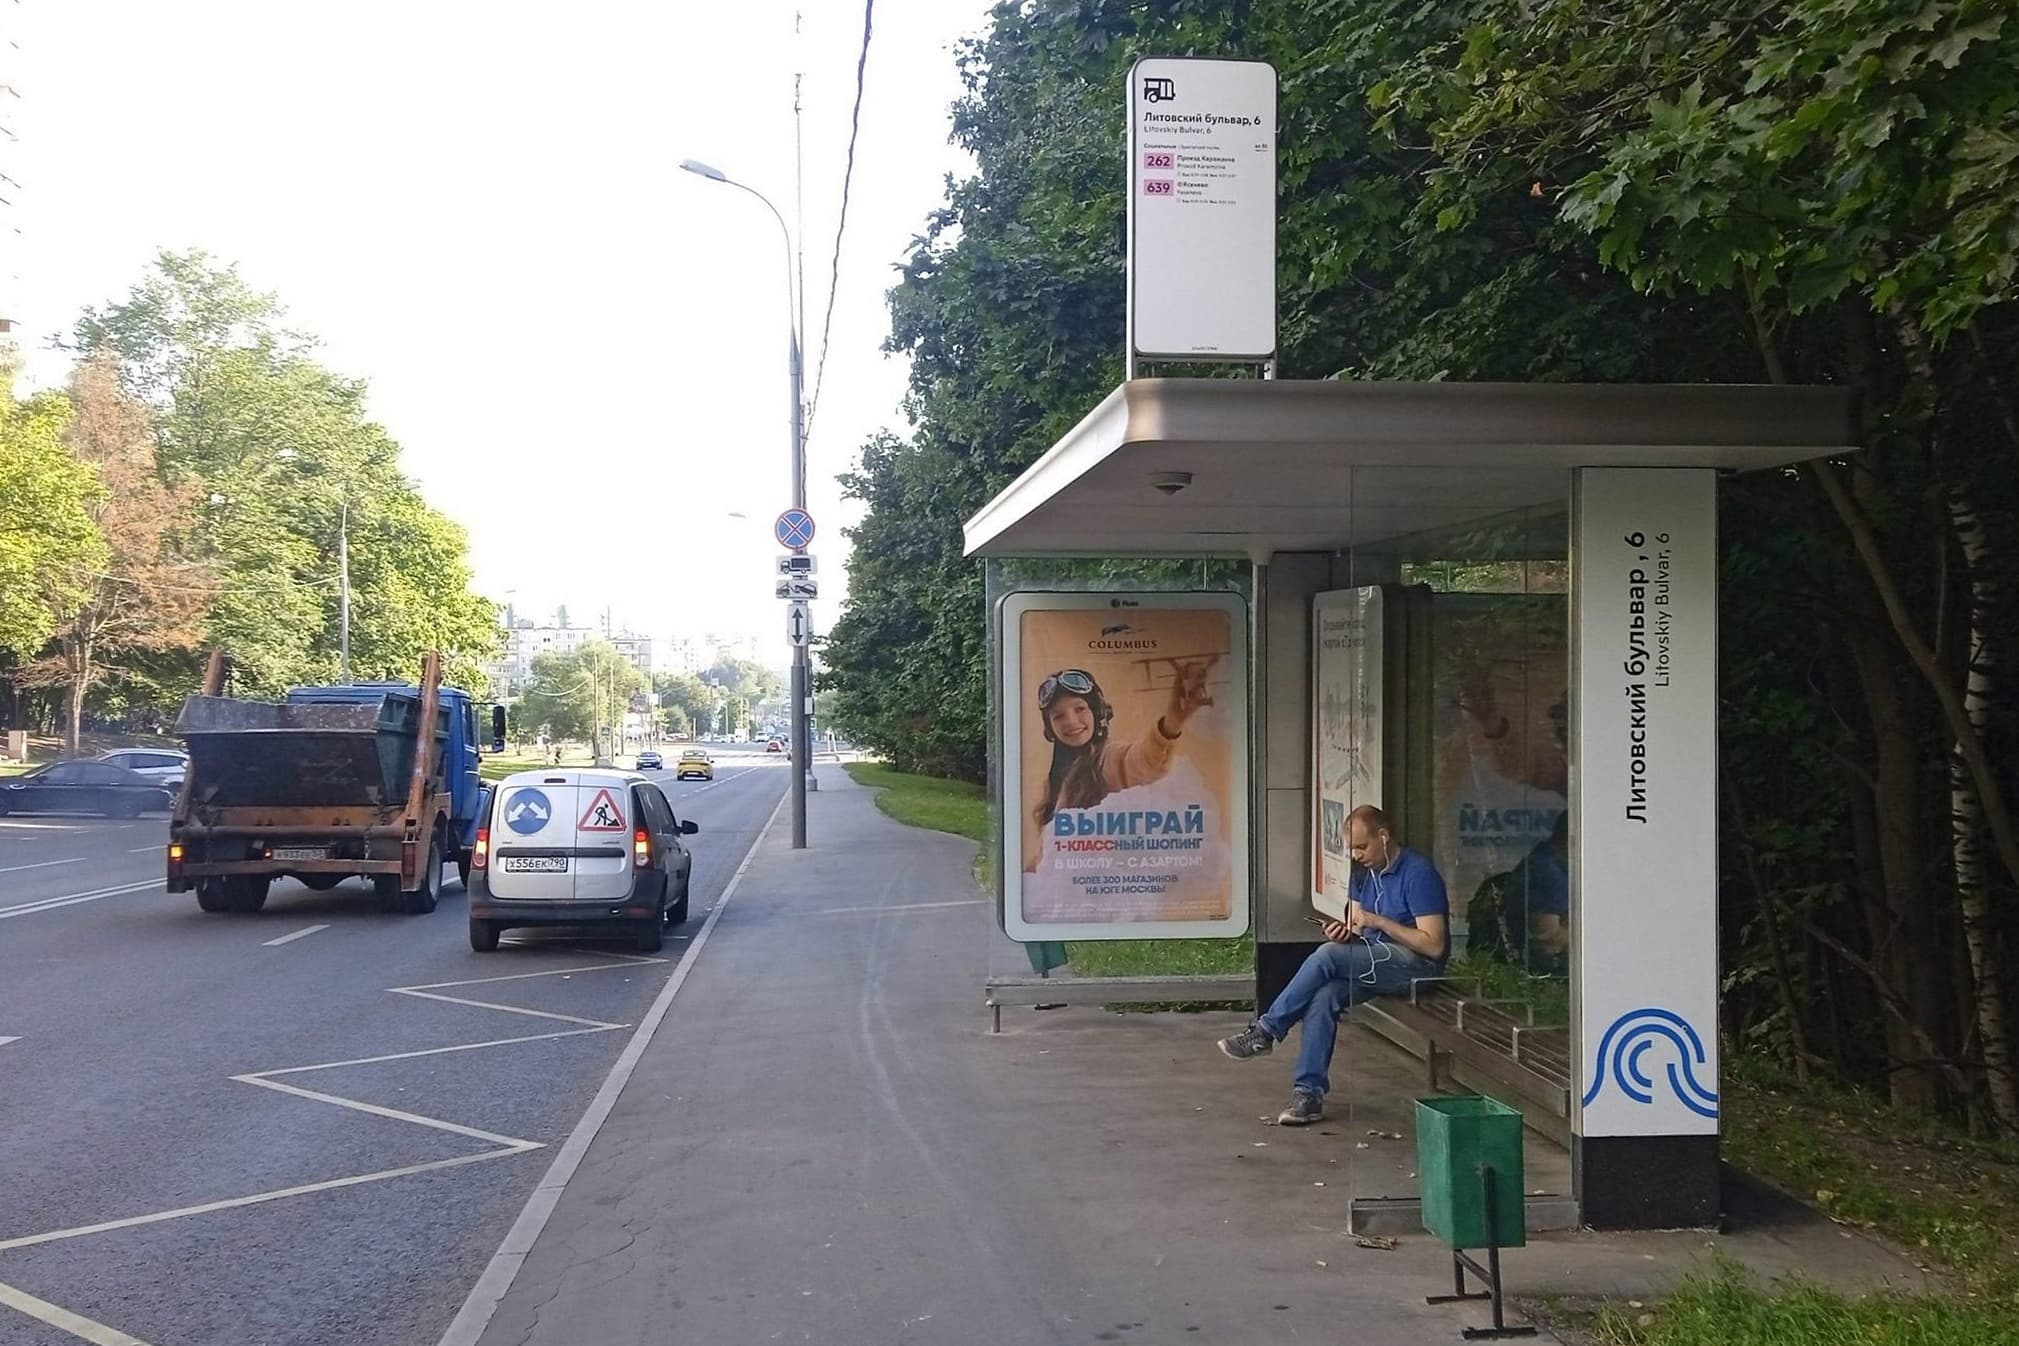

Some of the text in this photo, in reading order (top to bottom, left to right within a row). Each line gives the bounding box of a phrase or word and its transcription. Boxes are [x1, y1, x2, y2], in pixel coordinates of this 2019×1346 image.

[1144, 112, 1261, 127] Литовский бульвар, 6
[1147, 156, 1171, 167] 262
[1147, 183, 1170, 193] 639
[1624, 531, 1646, 549] 6
[1654, 532, 1673, 688] Litovskiy Bulvar, 6
[1088, 640, 1158, 649] COLUMBUS
[1625, 683, 1647, 825] Литовский
[1054, 804, 1204, 836] ВЫИГРАЙ
[1054, 837, 1204, 852] 1-КЛАССНЫЙ ШОПИНГ
[1066, 857, 1115, 870] ШКОЛУ
[1127, 858, 1137, 867] С
[1072, 874, 1179, 885] БОЛЕЕ 300 МАГАЗИНОВ
[1086, 884, 1166, 894] НА ЮГЕ МОСКВЫ
